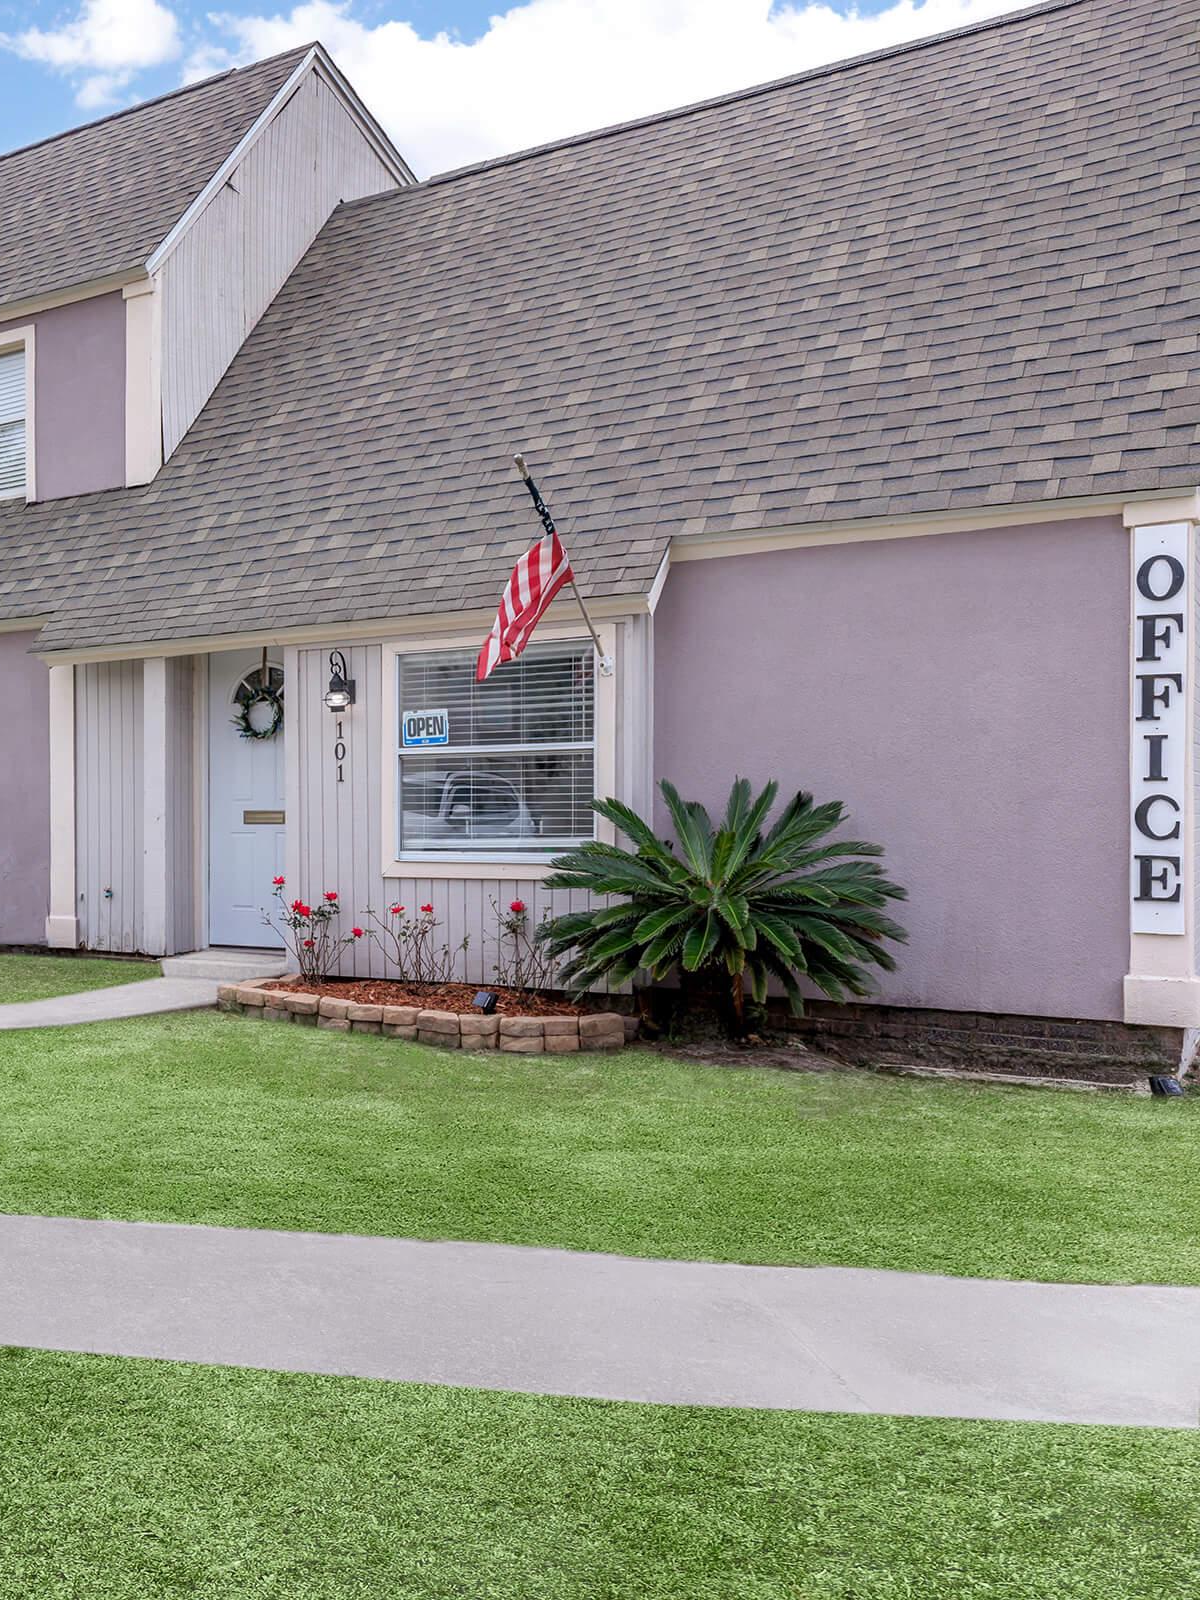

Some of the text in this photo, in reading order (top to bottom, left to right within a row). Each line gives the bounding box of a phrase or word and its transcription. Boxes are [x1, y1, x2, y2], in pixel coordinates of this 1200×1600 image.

[334, 720, 346, 783] 101
[407, 715, 444, 738] OPEN
[1133, 554, 1185, 903] OFFICE
